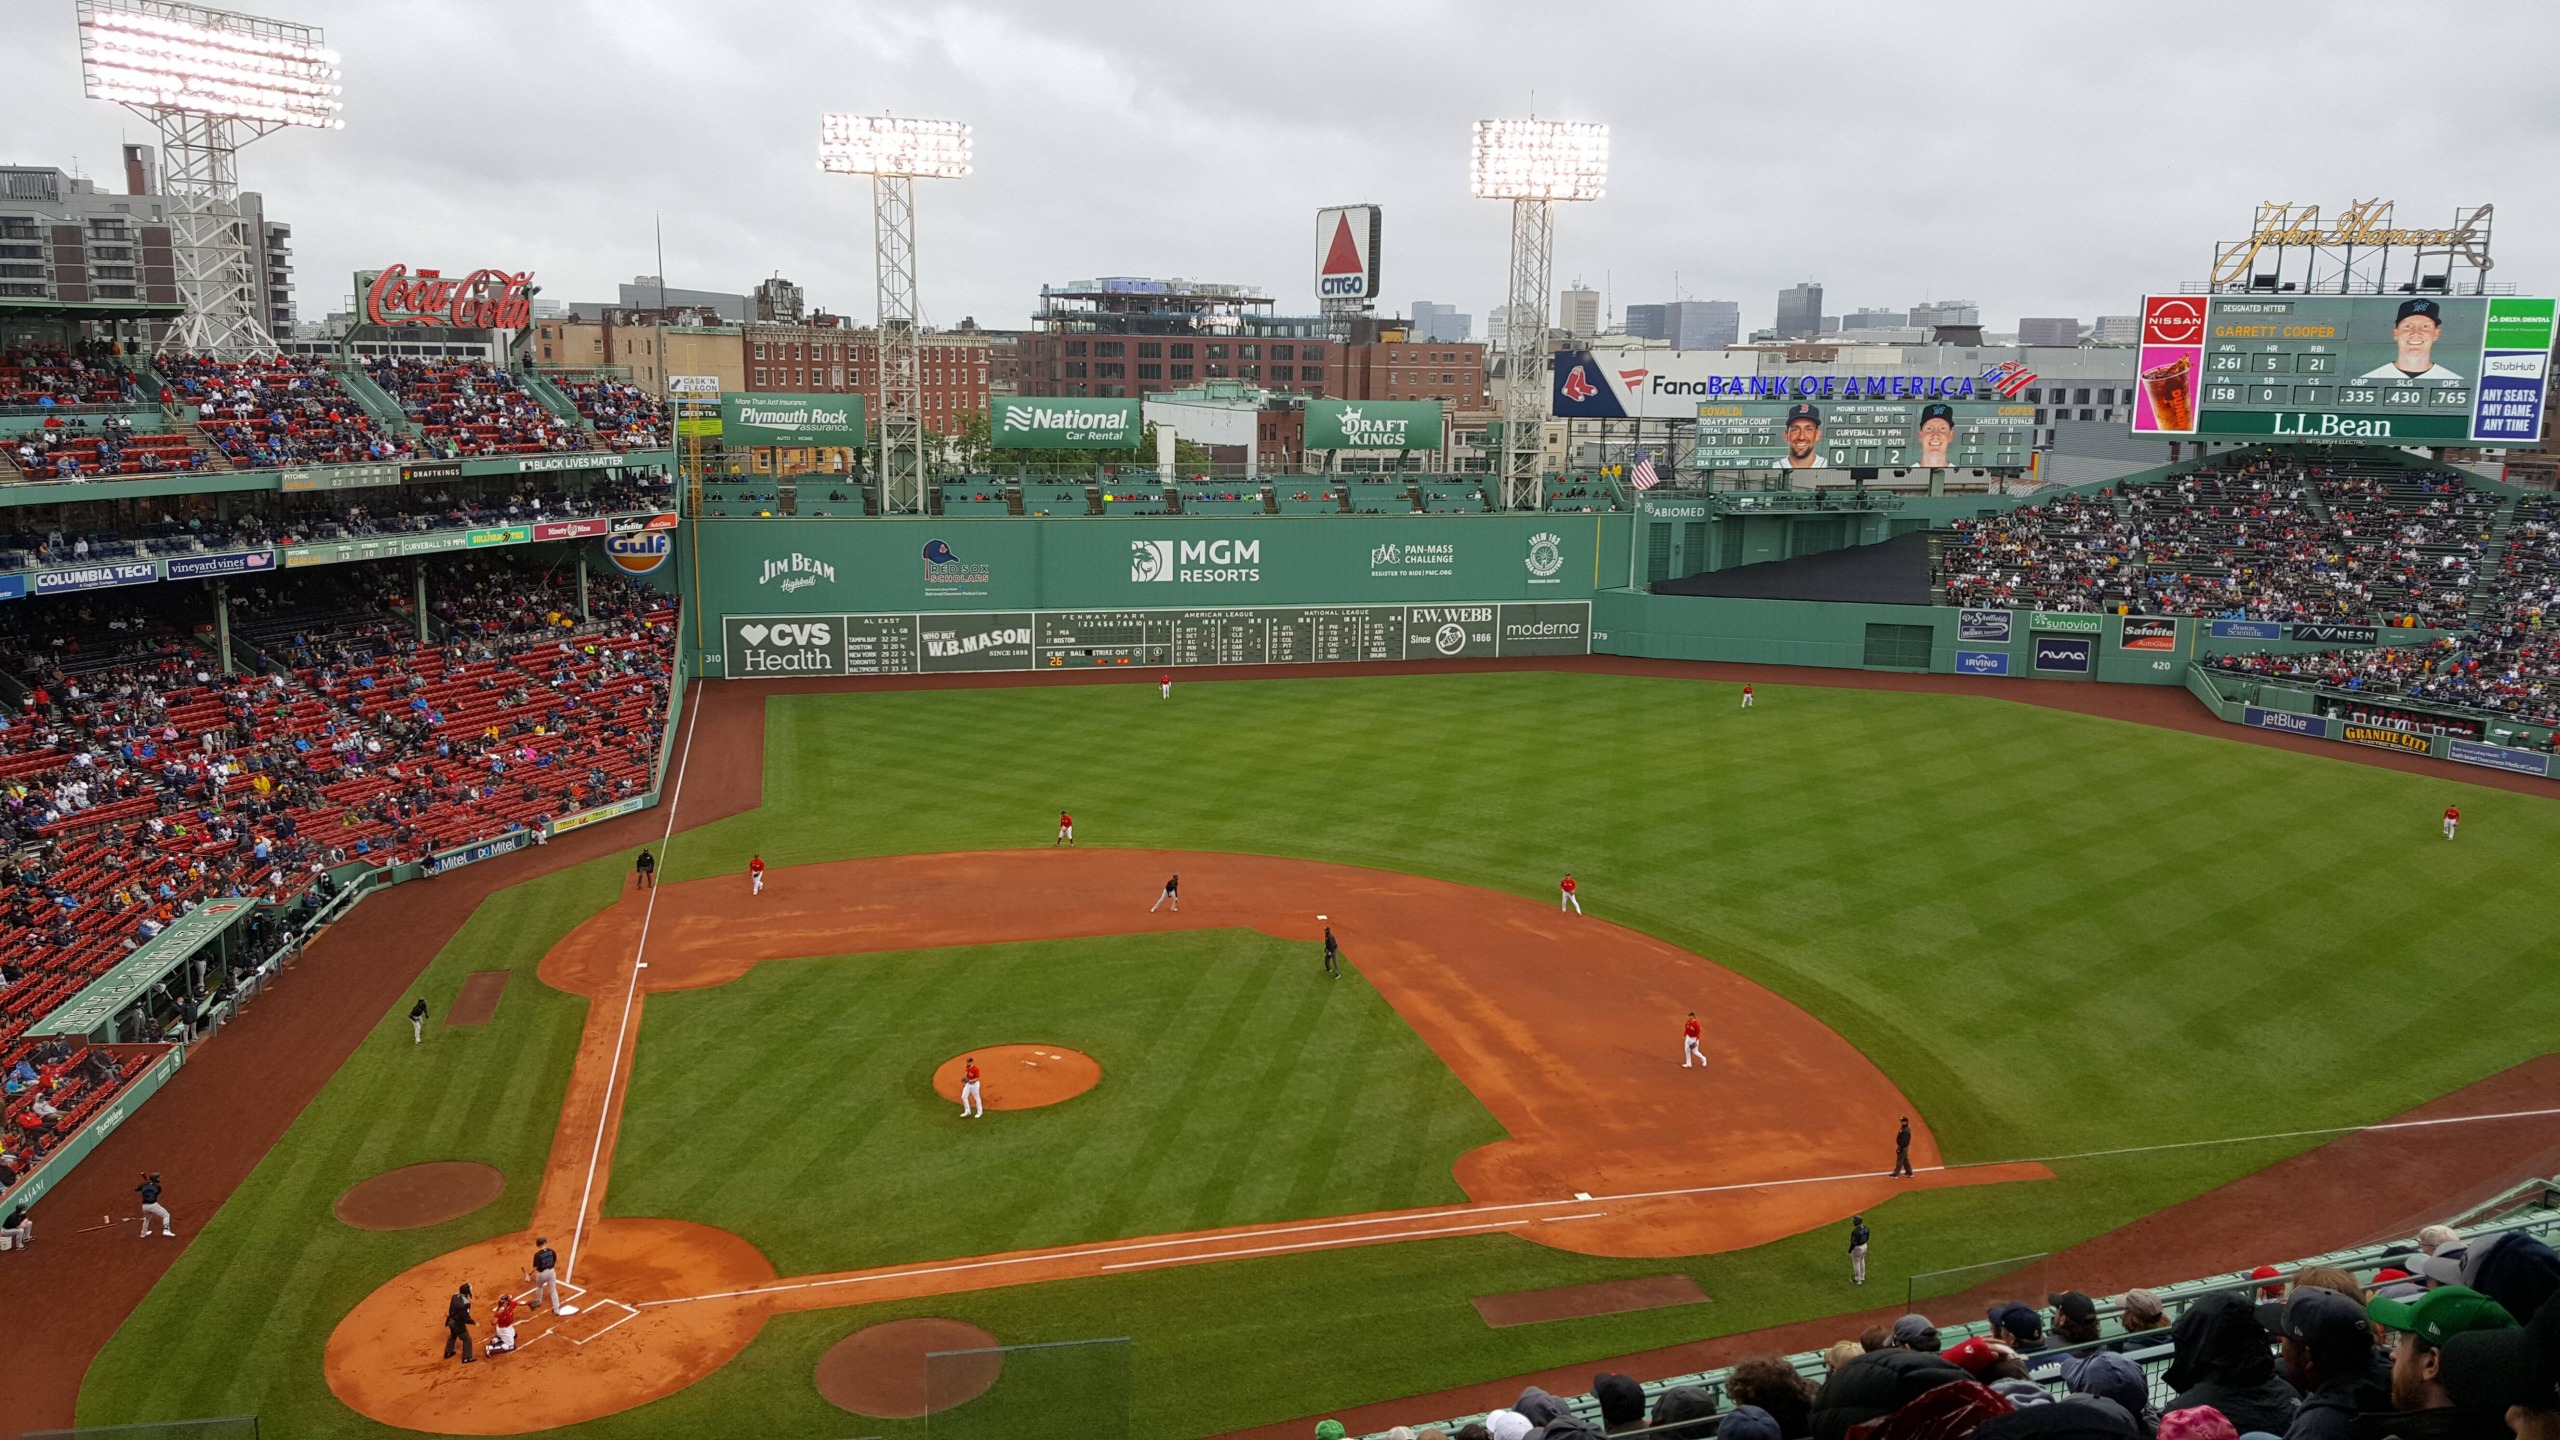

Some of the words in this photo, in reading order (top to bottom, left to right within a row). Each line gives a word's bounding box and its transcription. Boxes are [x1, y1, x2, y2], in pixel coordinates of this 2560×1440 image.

[2211, 201, 2322, 284] John
[2325, 198, 2494, 270] Hancock
[1322, 276, 1363, 295] CITGO
[367, 263, 535, 329] Coca-Cola
[2223, 305, 2263, 313] DESIGNATED
[2263, 305, 2286, 313] HITTER
[2149, 317, 2202, 325] NISSAN
[2216, 325, 2277, 337] GARRETT
[2283, 326, 2336, 338] COOPER
[2220, 344, 2236, 352] AVG
[2212, 357, 2241, 370] .261
[2268, 358, 2277, 370] 5
[2310, 359, 2324, 371] 21
[2492, 361, 2536, 371] StubHub
[1708, 376, 1789, 396] BANK
[1800, 376, 1836, 396] OF
[1844, 376, 1975, 396] AMERICA
[2396, 379, 2414, 387] SLG
[2442, 380, 2460, 388] OPS
[767, 398, 779, 406] Just
[2212, 388, 2235, 400] 158
[2264, 389, 2273, 401] 0
[2340, 391, 2375, 403] .335
[2385, 391, 2420, 404] .430
[2431, 392, 2467, 405] .765
[2482, 389, 2502, 401] ANY
[2504, 389, 2538, 403] SEATS,
[740, 408, 809, 424] Plymouth
[811, 409, 848, 424] Rock
[1700, 406, 1742, 416] EOVALDI
[1998, 407, 2035, 416] COOPER
[2482, 404, 2502, 416] ANY
[2504, 404, 2535, 418] GAME,
[1341, 419, 1409, 435] DRAFT
[1699, 418, 1727, 426] TODAY'S
[1728, 418, 1748, 426] PITCH
[1749, 418, 1771, 426] COUNT
[2273, 412, 2392, 437] L.L.Bean
[2483, 418, 2505, 431] ANY
[2506, 419, 2530, 431] TIME
[1066, 431, 1085, 441] Car
[1088, 430, 1124, 441] Rental
[1349, 432, 1406, 446] KINGS
[534, 458, 564, 471] BLACK
[565, 457, 590, 469] LIVES
[590, 455, 624, 467] MATTER
[413, 469, 460, 478] DRAFTKINGS
[1654, 507, 1705, 518] ABIOMED
[548, 526, 567, 536] Ninety
[577, 525, 591, 533] Nine
[614, 523, 643, 532] Safelite
[472, 533, 503, 544] SULLIVAN
[509, 531, 525, 540] TIRE
[404, 542, 441, 551] CURVEBALL
[453, 538, 466, 546] MPH
[607, 536, 666, 554] Gulf
[1405, 544, 1453, 554] PAN-MASS
[1180, 539, 1260, 565] MGM
[1405, 555, 1454, 563] CHALLENGE
[172, 559, 217, 574] vineyard
[217, 558, 244, 569] vines
[759, 558, 789, 585] JIM
[791, 552, 835, 583] BEAM
[931, 565, 957, 574] RED
[962, 565, 989, 574] SOX
[37, 568, 114, 587] COLUMBIA
[116, 564, 152, 579] TECH
[930, 574, 989, 583] SCHOLARS
[1180, 569, 1260, 583] RESORTS
[780, 575, 816, 593] Highball
[1412, 609, 1442, 623] F.W.
[1444, 607, 1492, 622] WEBB
[1506, 621, 1581, 636] moderna
[2046, 619, 2098, 631] sunovion
[2233, 623, 2256, 631] Boston
[770, 623, 831, 646] CVS
[922, 632, 940, 640] WHO
[941, 632, 955, 640] BUT
[1593, 632, 1607, 640] 379
[2124, 626, 2175, 637] Safelite
[2227, 628, 2264, 637] Scientific
[2337, 630, 2376, 641] NESN
[927, 628, 1032, 657] W.B.MASON
[1410, 634, 1431, 644] Since
[1471, 633, 1492, 643] 1866
[2137, 639, 2173, 648] AutoGlass
[705, 654, 721, 663] 310
[744, 649, 832, 671] Health
[2039, 650, 2086, 661] nuna
[1965, 658, 1999, 668] IRVING
[2152, 661, 2171, 671] 420
[2261, 711, 2308, 731] jetBlue
[2345, 727, 2400, 744] GRANITE
[2401, 733, 2430, 752] CITY
[623, 801, 639, 809] TRULY
[592, 810, 607, 819] TRULY
[558, 819, 575, 828] TRULY
[491, 838, 516, 855] Mitel
[441, 852, 468, 871] Mitel
